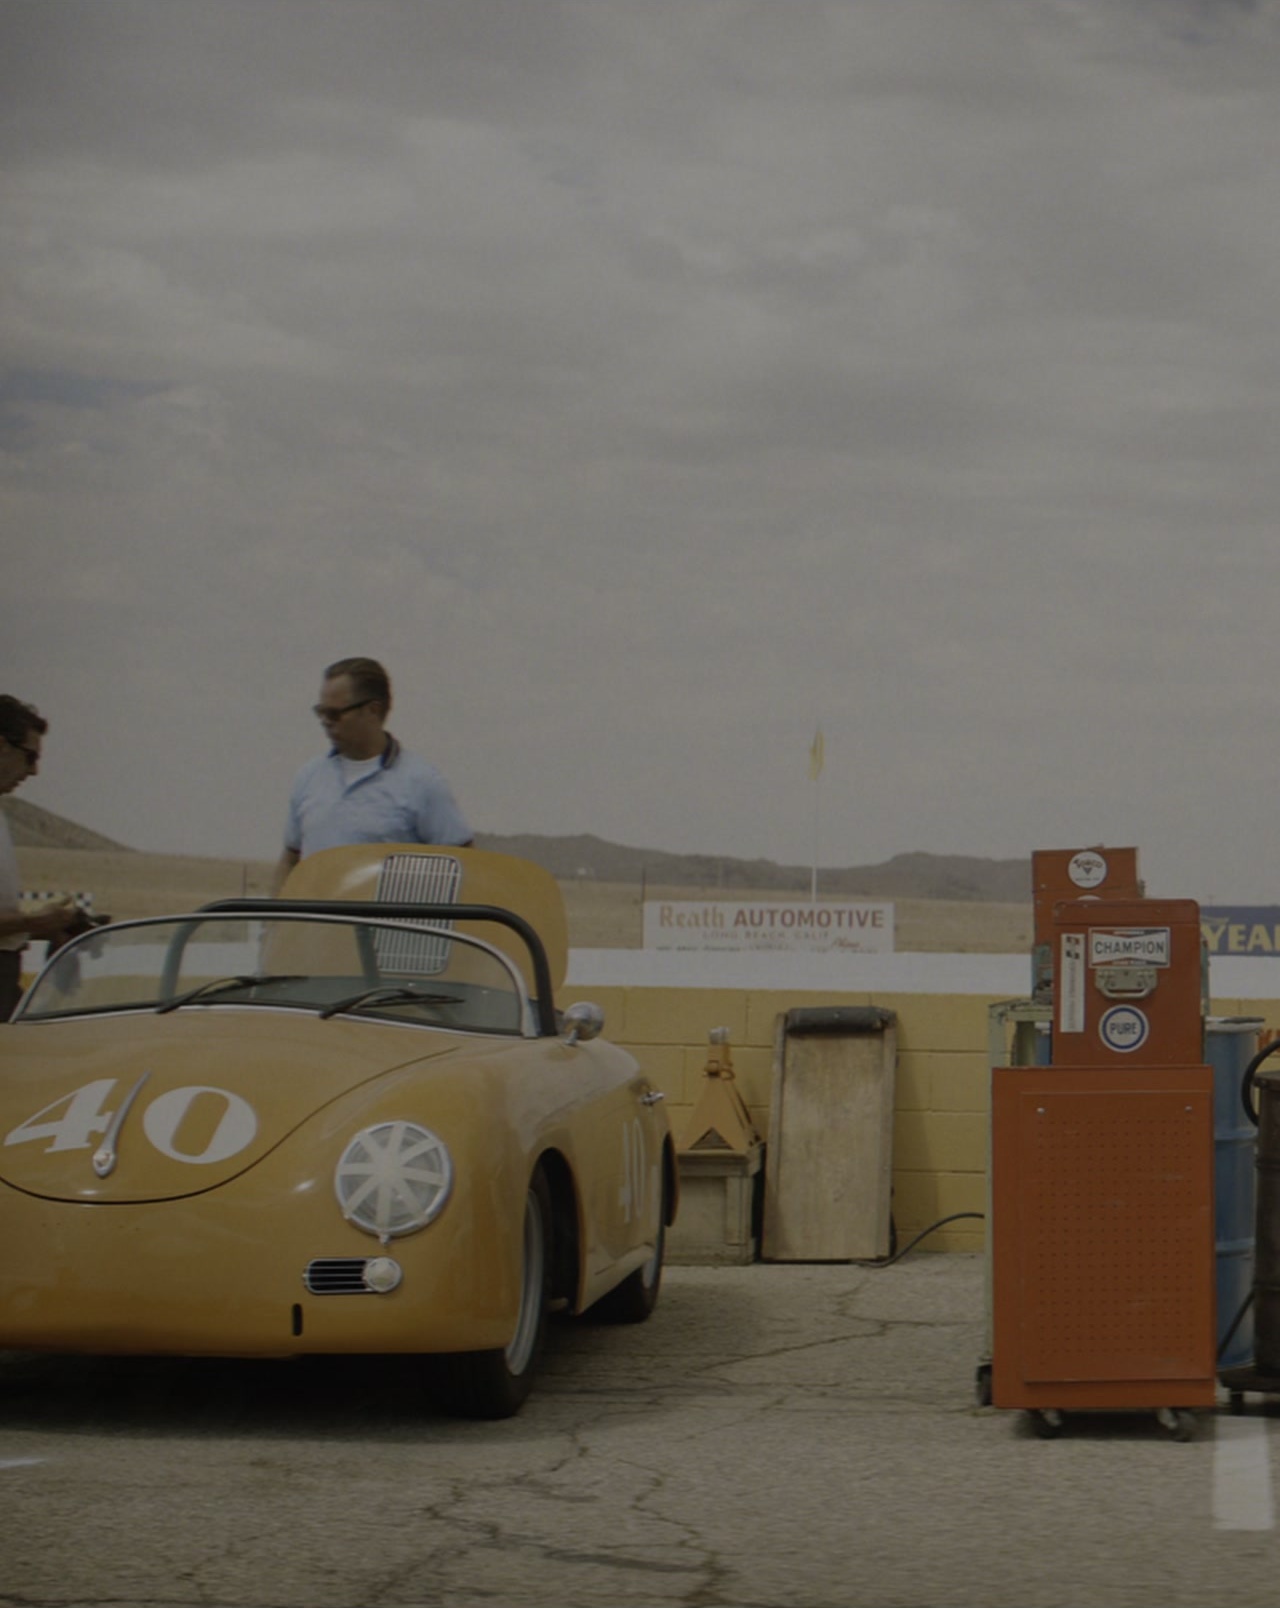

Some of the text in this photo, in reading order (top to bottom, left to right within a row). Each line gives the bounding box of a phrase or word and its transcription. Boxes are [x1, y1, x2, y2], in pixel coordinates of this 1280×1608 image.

[659, 906, 885, 928] Reath AUTOMOTIVE
[1094, 941, 1165, 955] CHAMPION
[1109, 1022, 1138, 1036] PURE
[4, 1078, 257, 1164] 40
